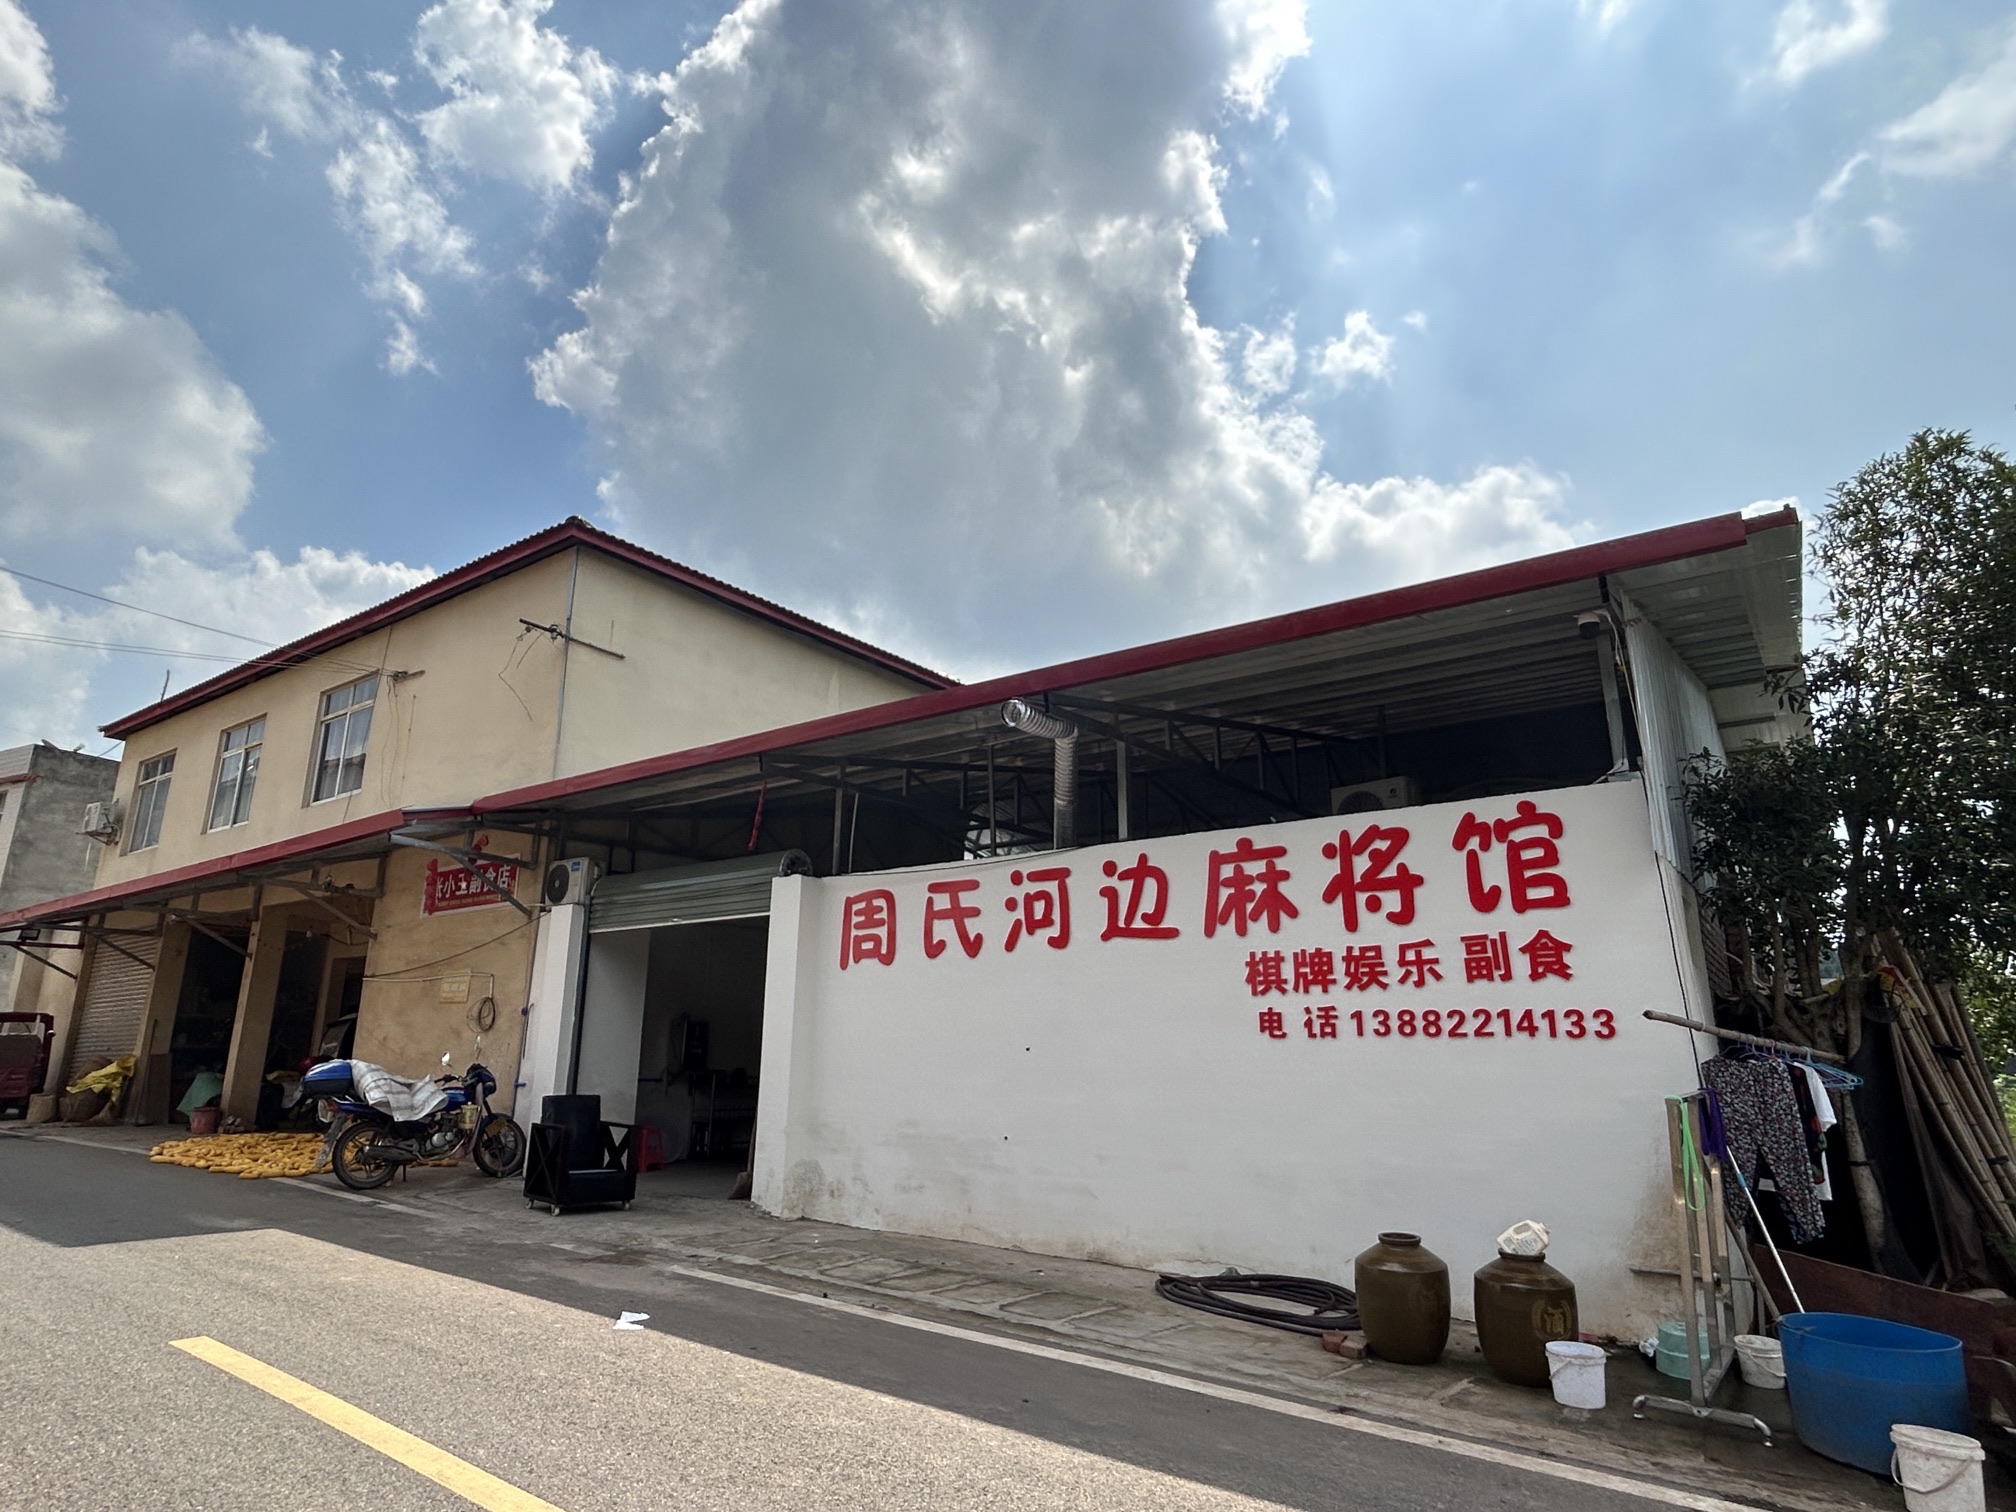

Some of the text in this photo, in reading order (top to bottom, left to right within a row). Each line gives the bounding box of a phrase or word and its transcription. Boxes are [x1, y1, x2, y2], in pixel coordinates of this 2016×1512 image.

[839, 799, 1572, 971] 周氏河边麻将馆
[1350, 1007, 1617, 1040] 13882214133
